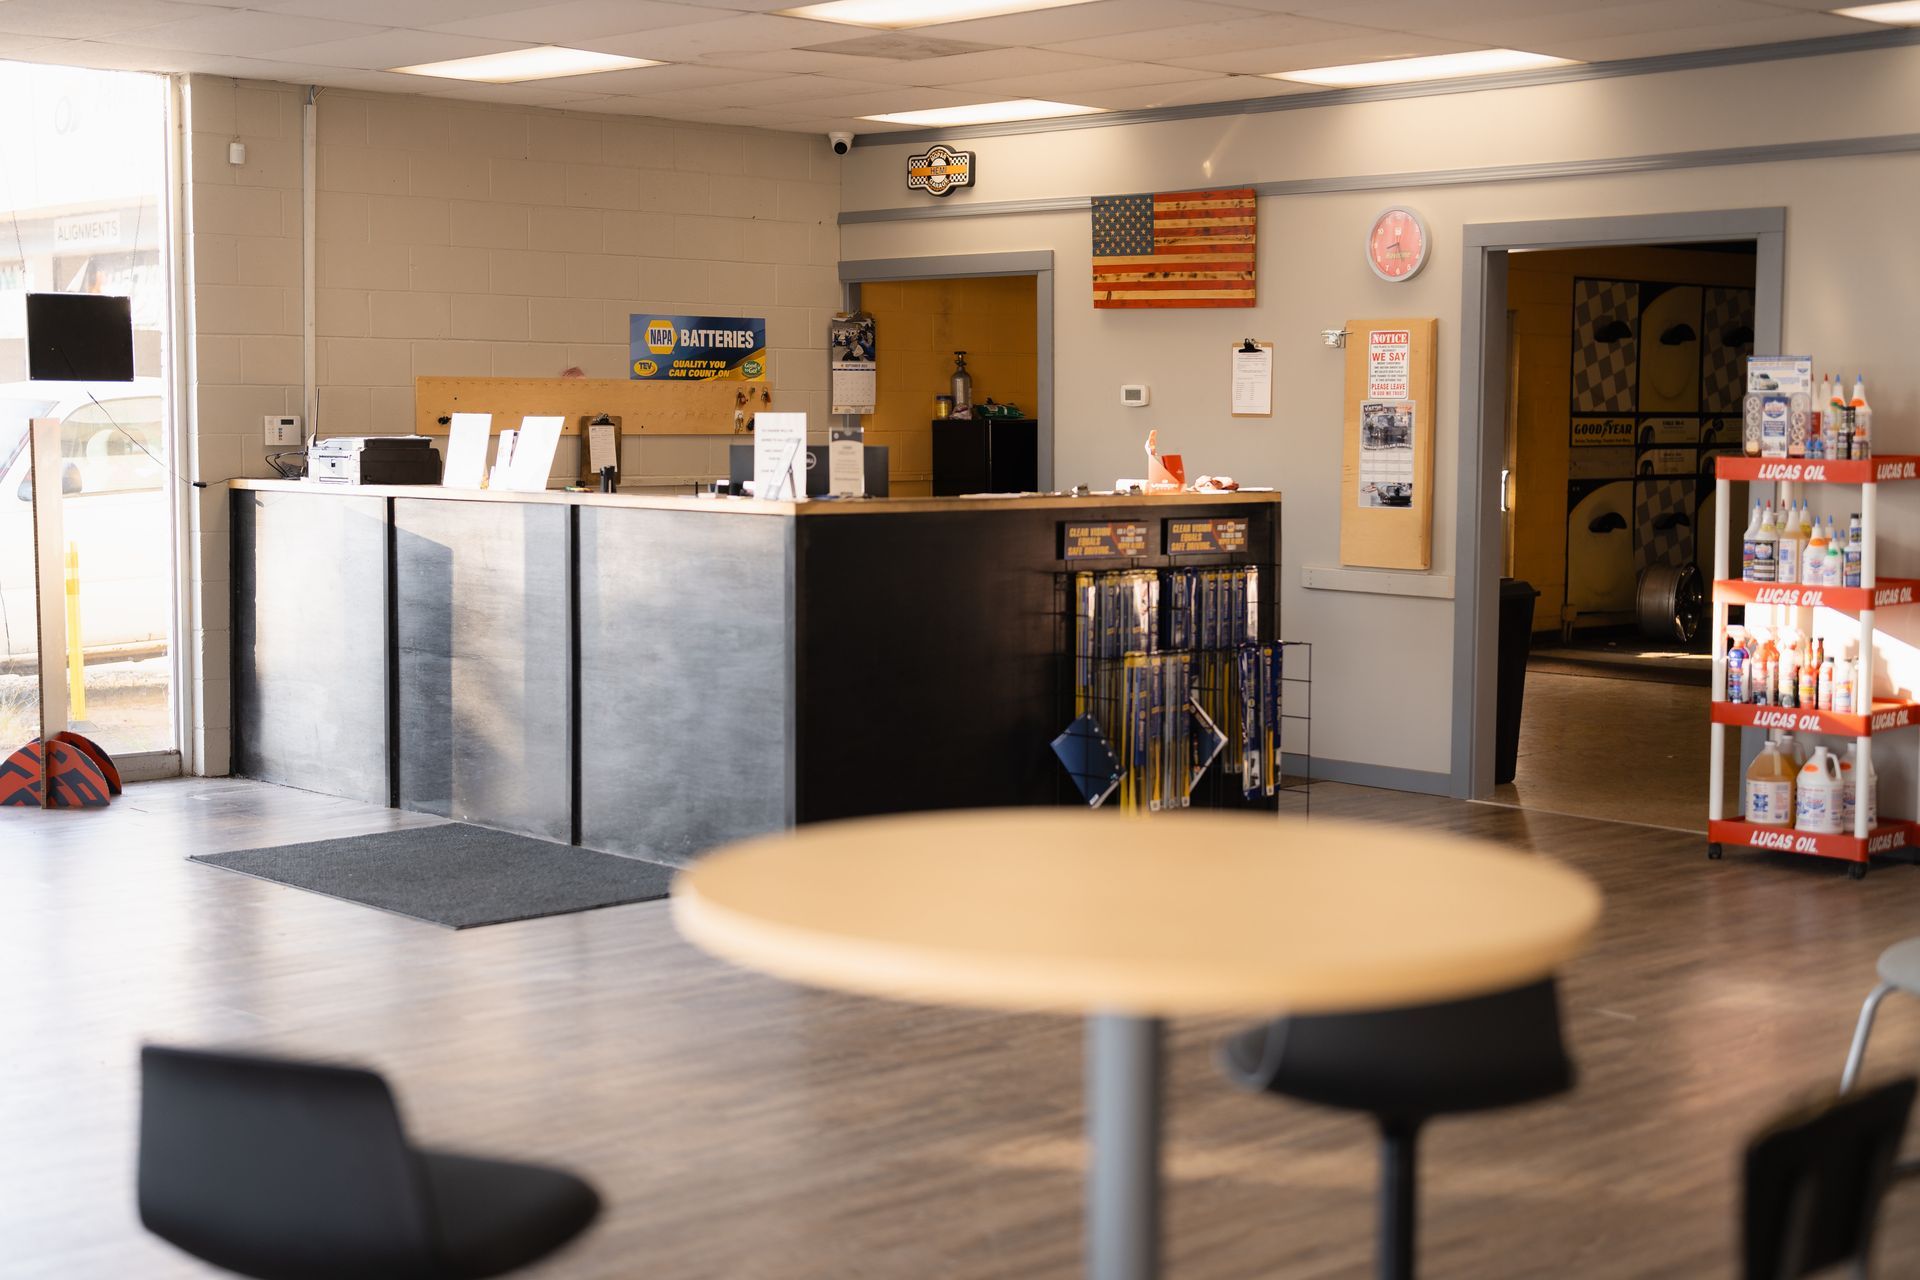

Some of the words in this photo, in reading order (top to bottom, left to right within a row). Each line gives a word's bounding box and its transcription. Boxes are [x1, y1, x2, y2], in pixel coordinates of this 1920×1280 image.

[930, 167, 947, 175] HEMI
[929, 179, 949, 188] GARAGE
[57, 220, 119, 241] ALIGNMENTS
[650, 329, 673, 345] NAPA
[680, 329, 754, 348] BATTERIES
[1372, 333, 1408, 344] NOTICE
[1372, 352, 1386, 362] WE
[1389, 352, 1406, 362] SAY
[638, 362, 652, 370] TEV
[673, 360, 708, 368] QUALITY
[710, 361, 726, 369] YOU
[668, 369, 687, 377] CAN
[688, 370, 715, 378] COUNT
[716, 370, 730, 378] ON
[1574, 420, 1632, 437] GOODYEAR
[1758, 464, 1802, 480] LUCAS
[1804, 465, 1826, 480] OIL
[1877, 463, 1902, 480] LUCAS
[1904, 462, 1916, 478] OIL
[1069, 528, 1089, 538] CLEAR
[1172, 524, 1192, 534] CLEAR
[1193, 523, 1212, 532] VISION
[1180, 533, 1202, 542] EQUALS
[1068, 546, 1083, 556] SAFE
[1171, 542, 1186, 551] SAFE
[1756, 588, 1800, 604] LUCAS
[1802, 591, 1824, 606] OIL
[1874, 588, 1899, 604] LUCAS
[1900, 587, 1912, 602] OIL
[1753, 711, 1797, 728] LUCAS
[1799, 714, 1822, 730] OIL
[1872, 712, 1896, 730] LUCAS
[1896, 710, 1908, 724] OIL
[1750, 830, 1794, 848] LUCAS
[1796, 836, 1818, 852] OIL
[1868, 835, 1892, 852] LUCAS
[1893, 832, 1905, 846] OIL
